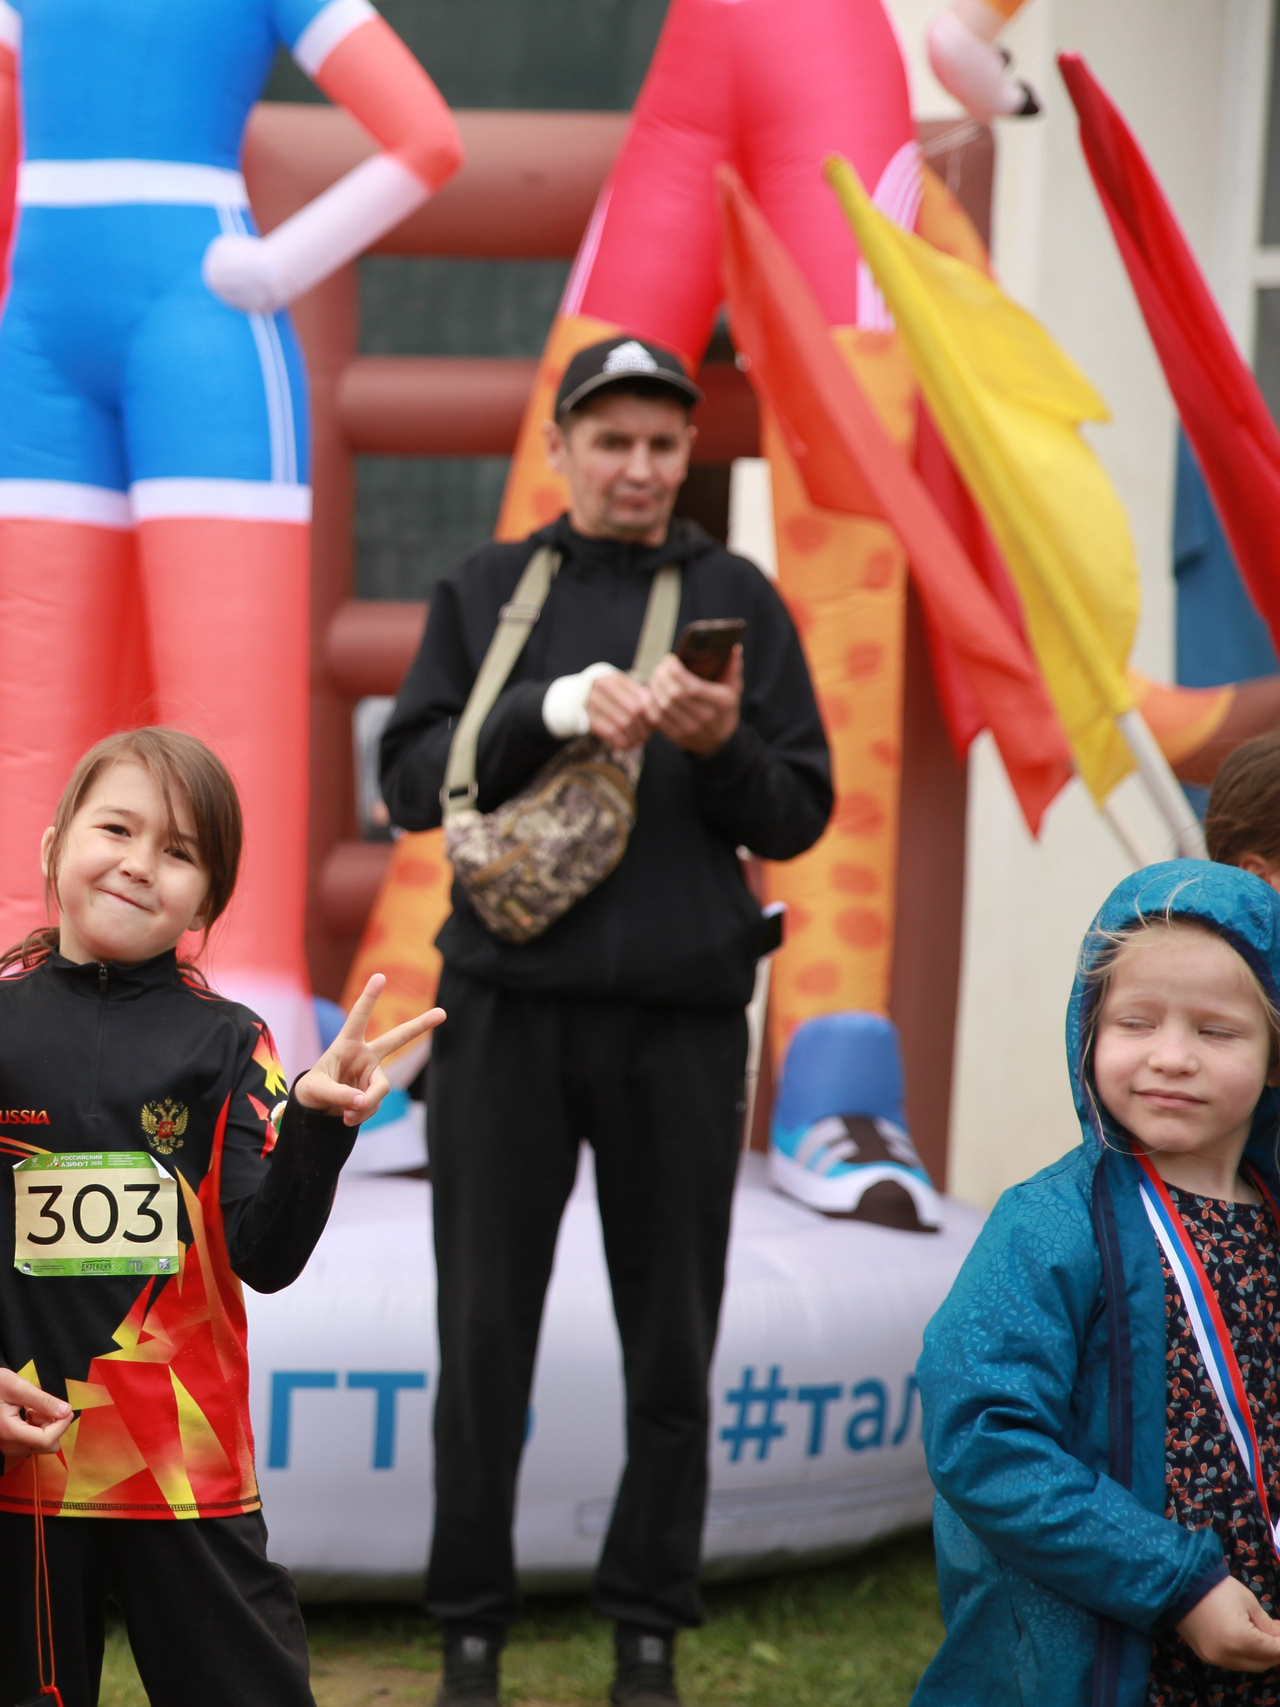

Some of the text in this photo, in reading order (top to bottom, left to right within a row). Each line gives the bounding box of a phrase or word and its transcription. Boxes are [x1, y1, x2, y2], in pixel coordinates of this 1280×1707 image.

[60, 1153, 103, 1161] РОССИЙСКИЙ
[26, 1183, 163, 1246] 303
[266, 1370, 536, 1471] ГТ
